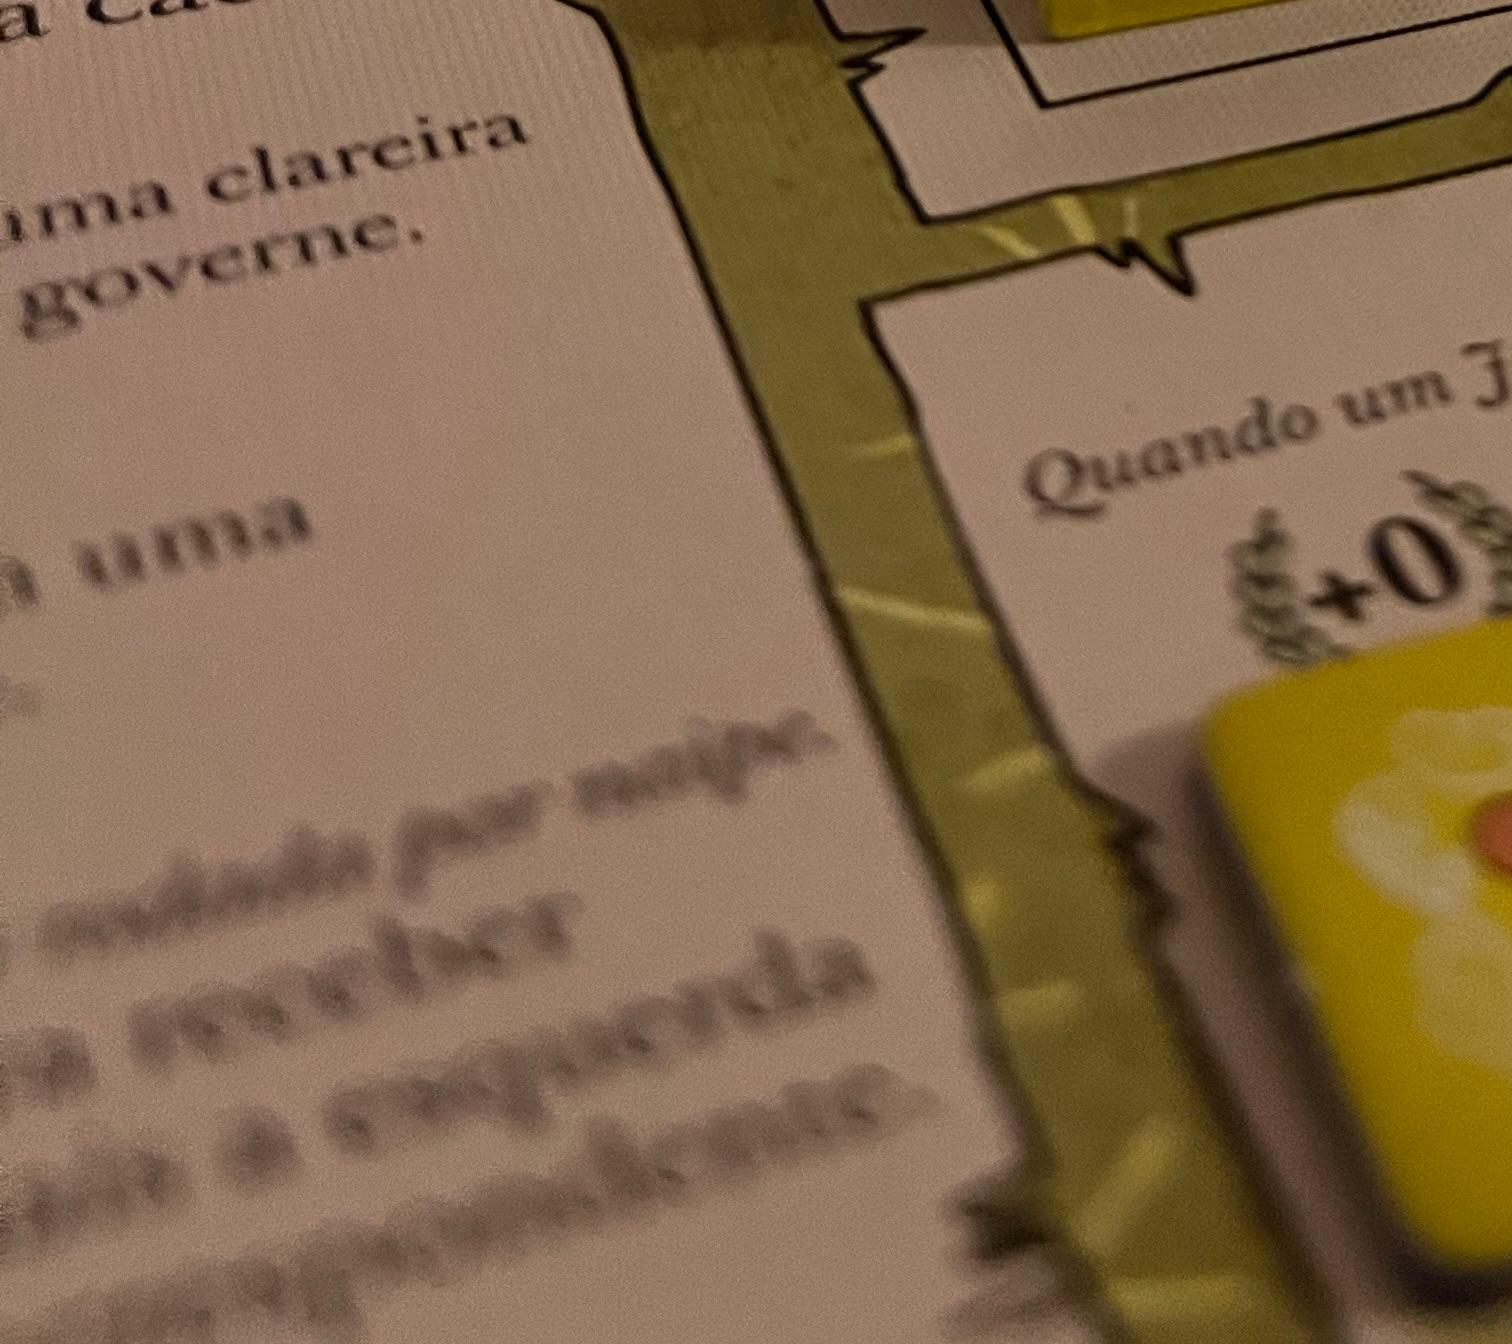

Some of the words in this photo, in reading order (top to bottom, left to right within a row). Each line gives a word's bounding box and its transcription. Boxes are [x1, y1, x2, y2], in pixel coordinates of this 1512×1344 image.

[204, 108, 530, 207] clareira
[20, 209, 425, 342] governe.
[1023, 393, 1321, 520] Quando
[1336, 368, 1455, 427] um
[74, 492, 314, 592] uma
[1309, 513, 1465, 622] +0
